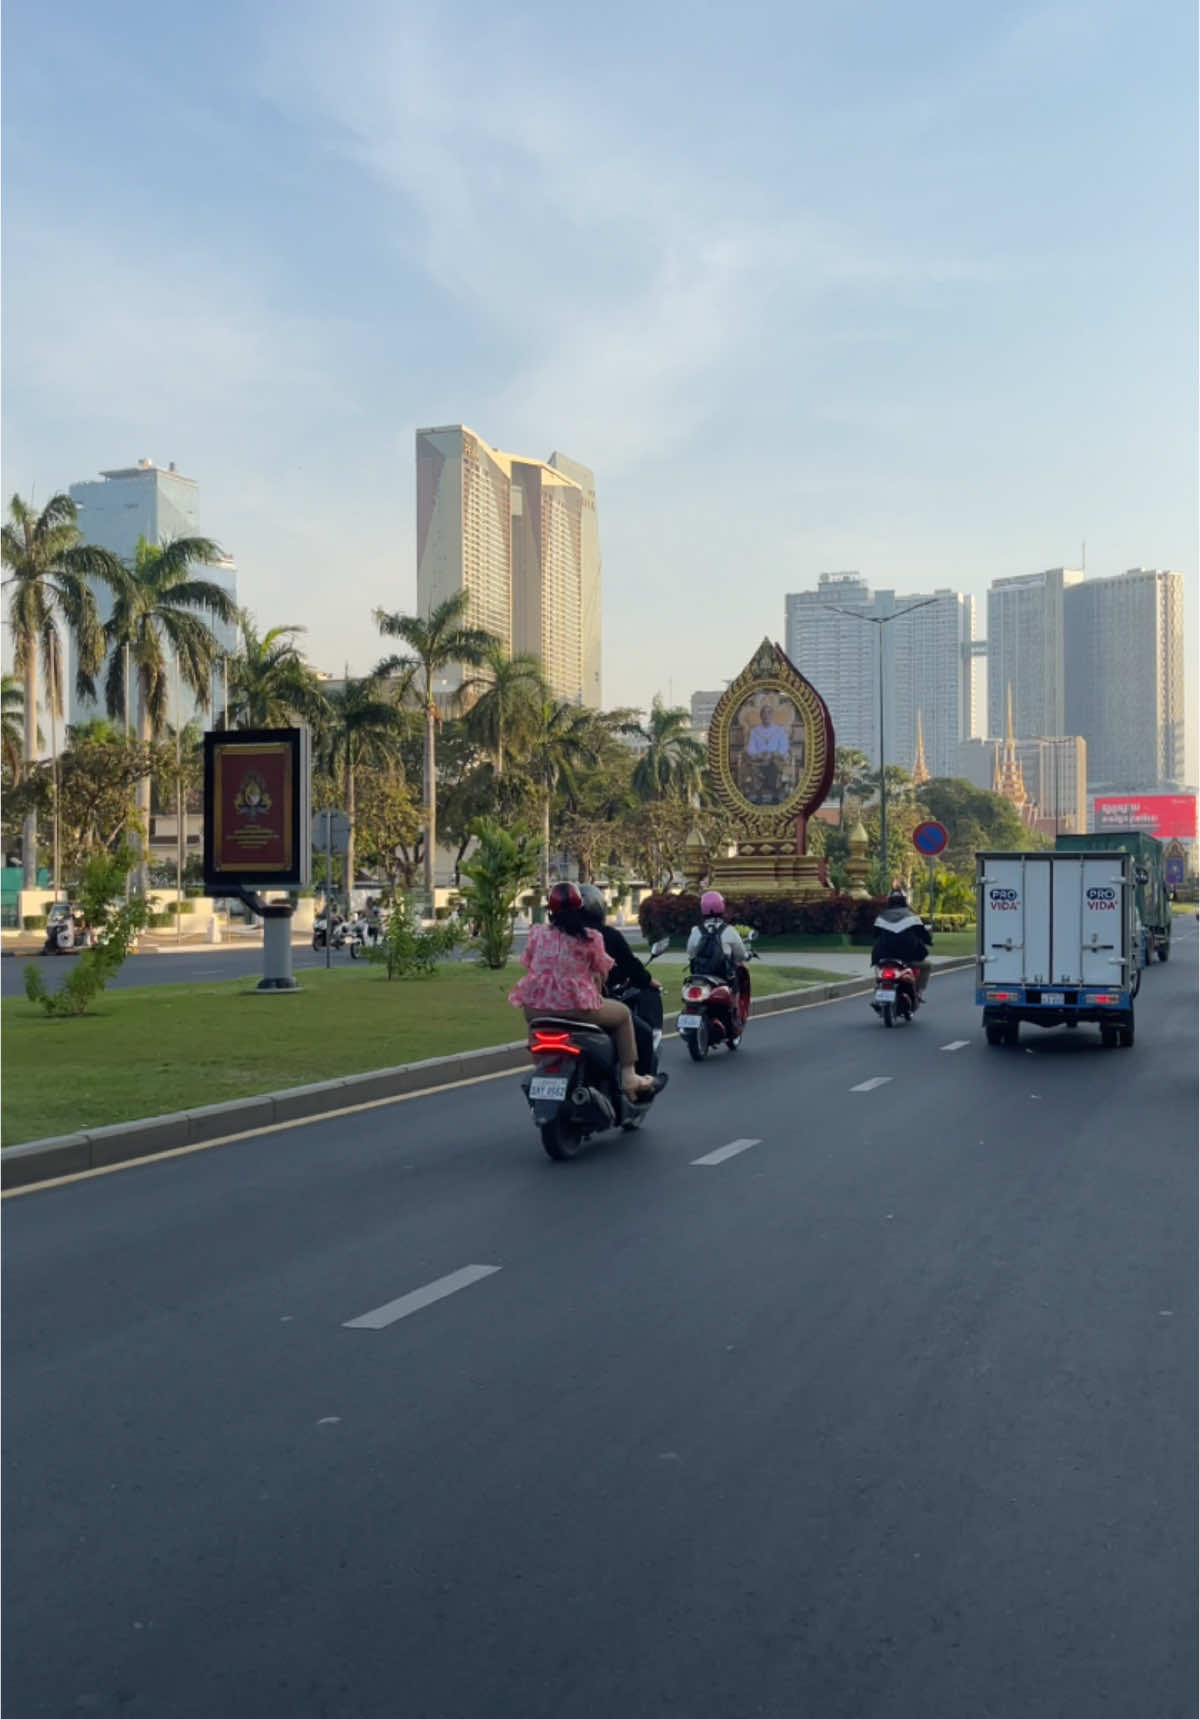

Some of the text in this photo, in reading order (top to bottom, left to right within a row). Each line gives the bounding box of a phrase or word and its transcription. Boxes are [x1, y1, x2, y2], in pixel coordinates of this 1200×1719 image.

[990, 889, 1018, 900] PRO
[1087, 888, 1115, 900] PRO
[990, 901, 1018, 911] VIDA
[1087, 901, 1116, 911] VIDA
